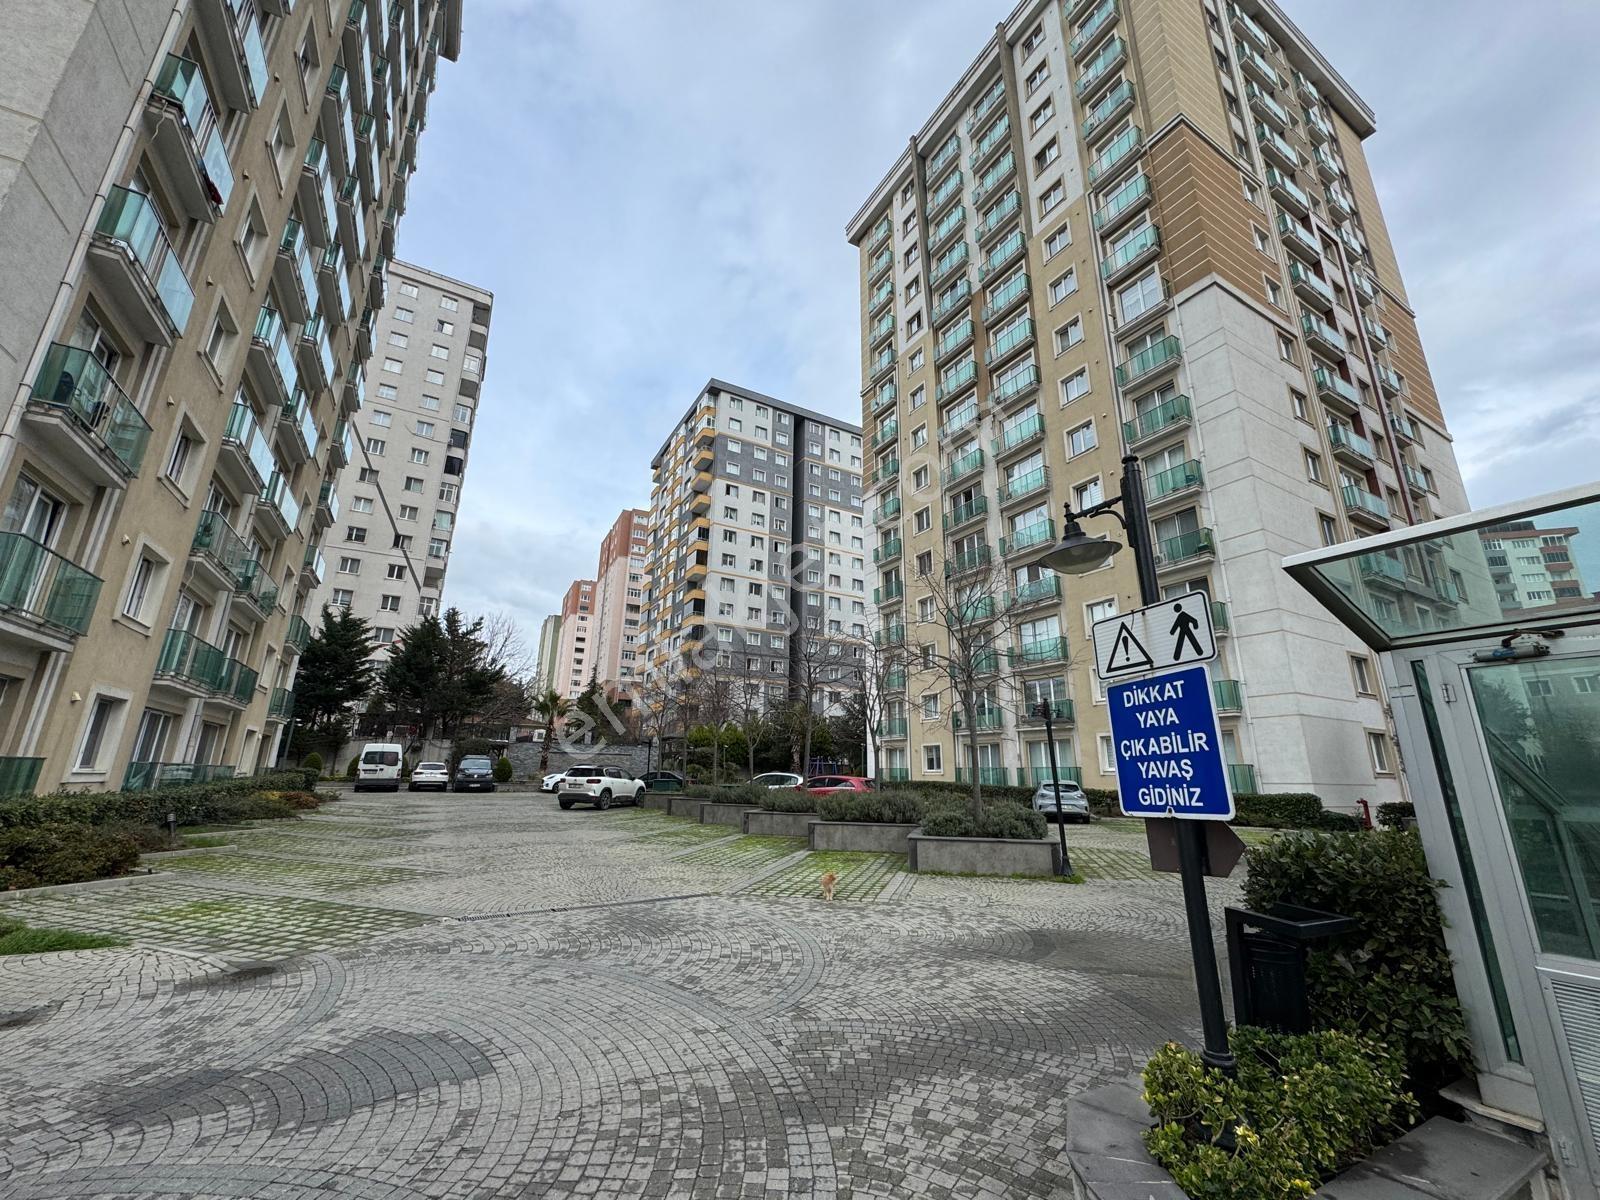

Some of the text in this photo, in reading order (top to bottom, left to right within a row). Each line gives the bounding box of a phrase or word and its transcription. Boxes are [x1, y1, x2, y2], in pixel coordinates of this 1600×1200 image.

[1123, 680, 1184, 707] DİKKAT
[1136, 708, 1179, 728] YAYA
[1121, 730, 1209, 761] ÇIKABİLİR
[1138, 759, 1193, 780] YAVAŞ
[1139, 784, 1203, 807] GİDİNİZ
